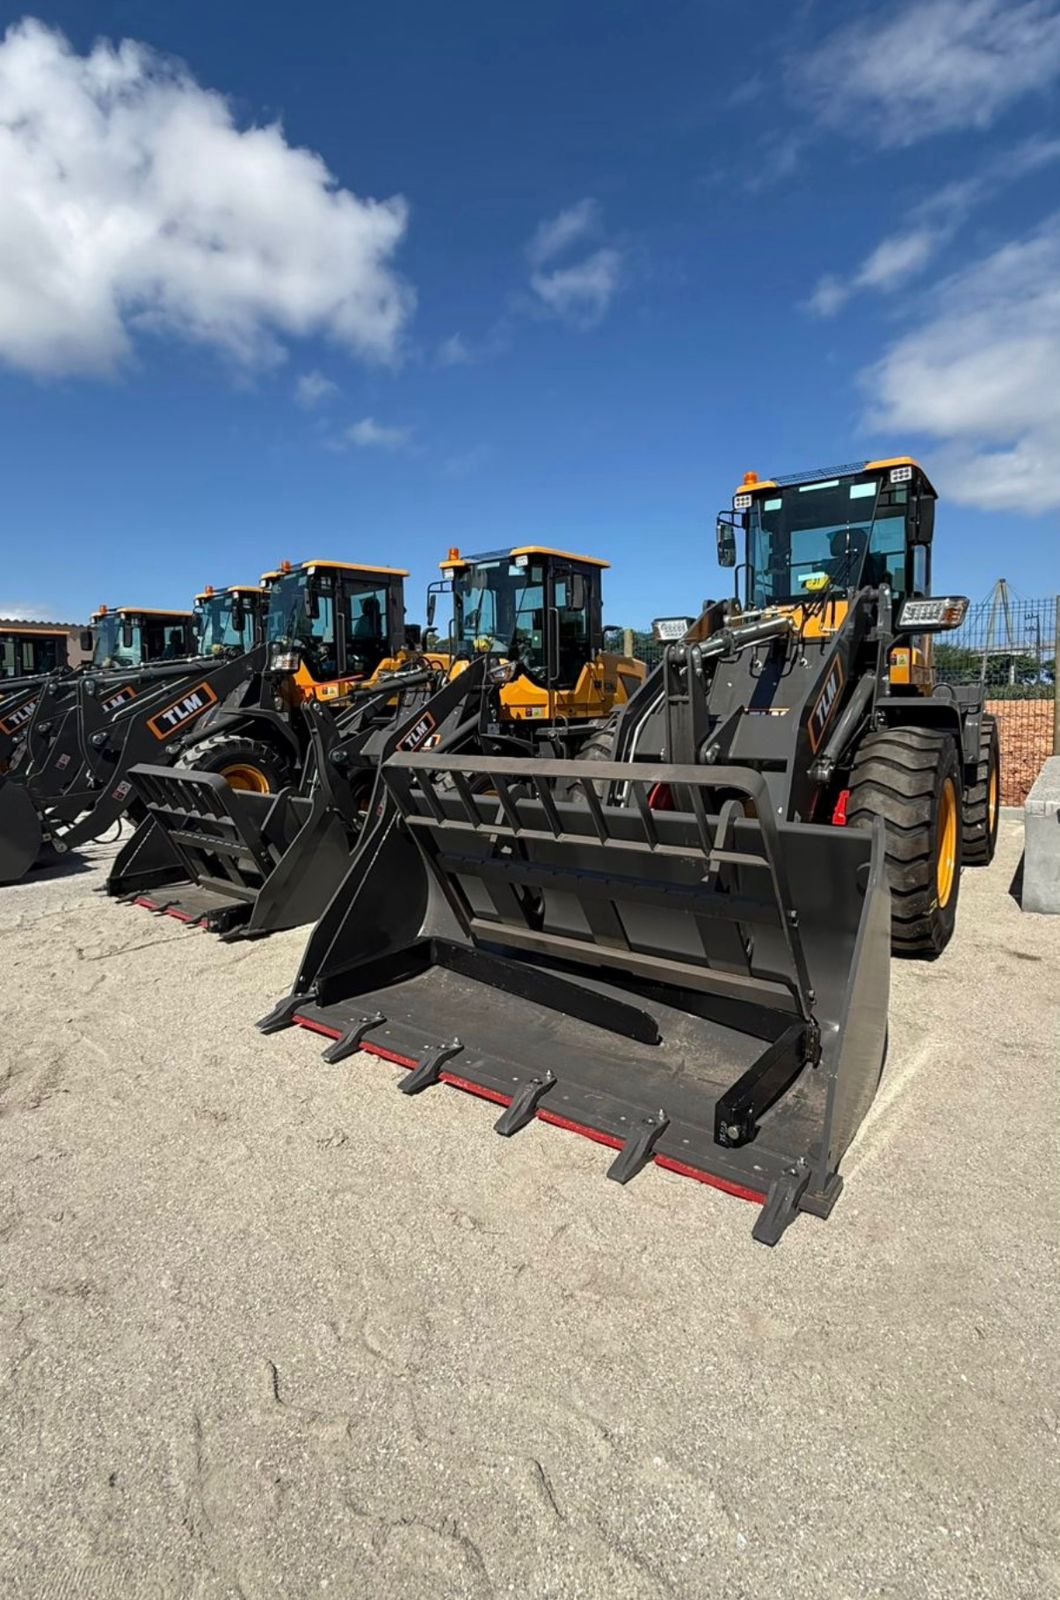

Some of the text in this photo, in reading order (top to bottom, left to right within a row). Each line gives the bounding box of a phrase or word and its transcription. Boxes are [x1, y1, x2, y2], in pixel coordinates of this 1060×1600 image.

[162, 693, 203, 725] TLM
[816, 672, 836, 728] TLM
[405, 721, 428, 747] TLM
